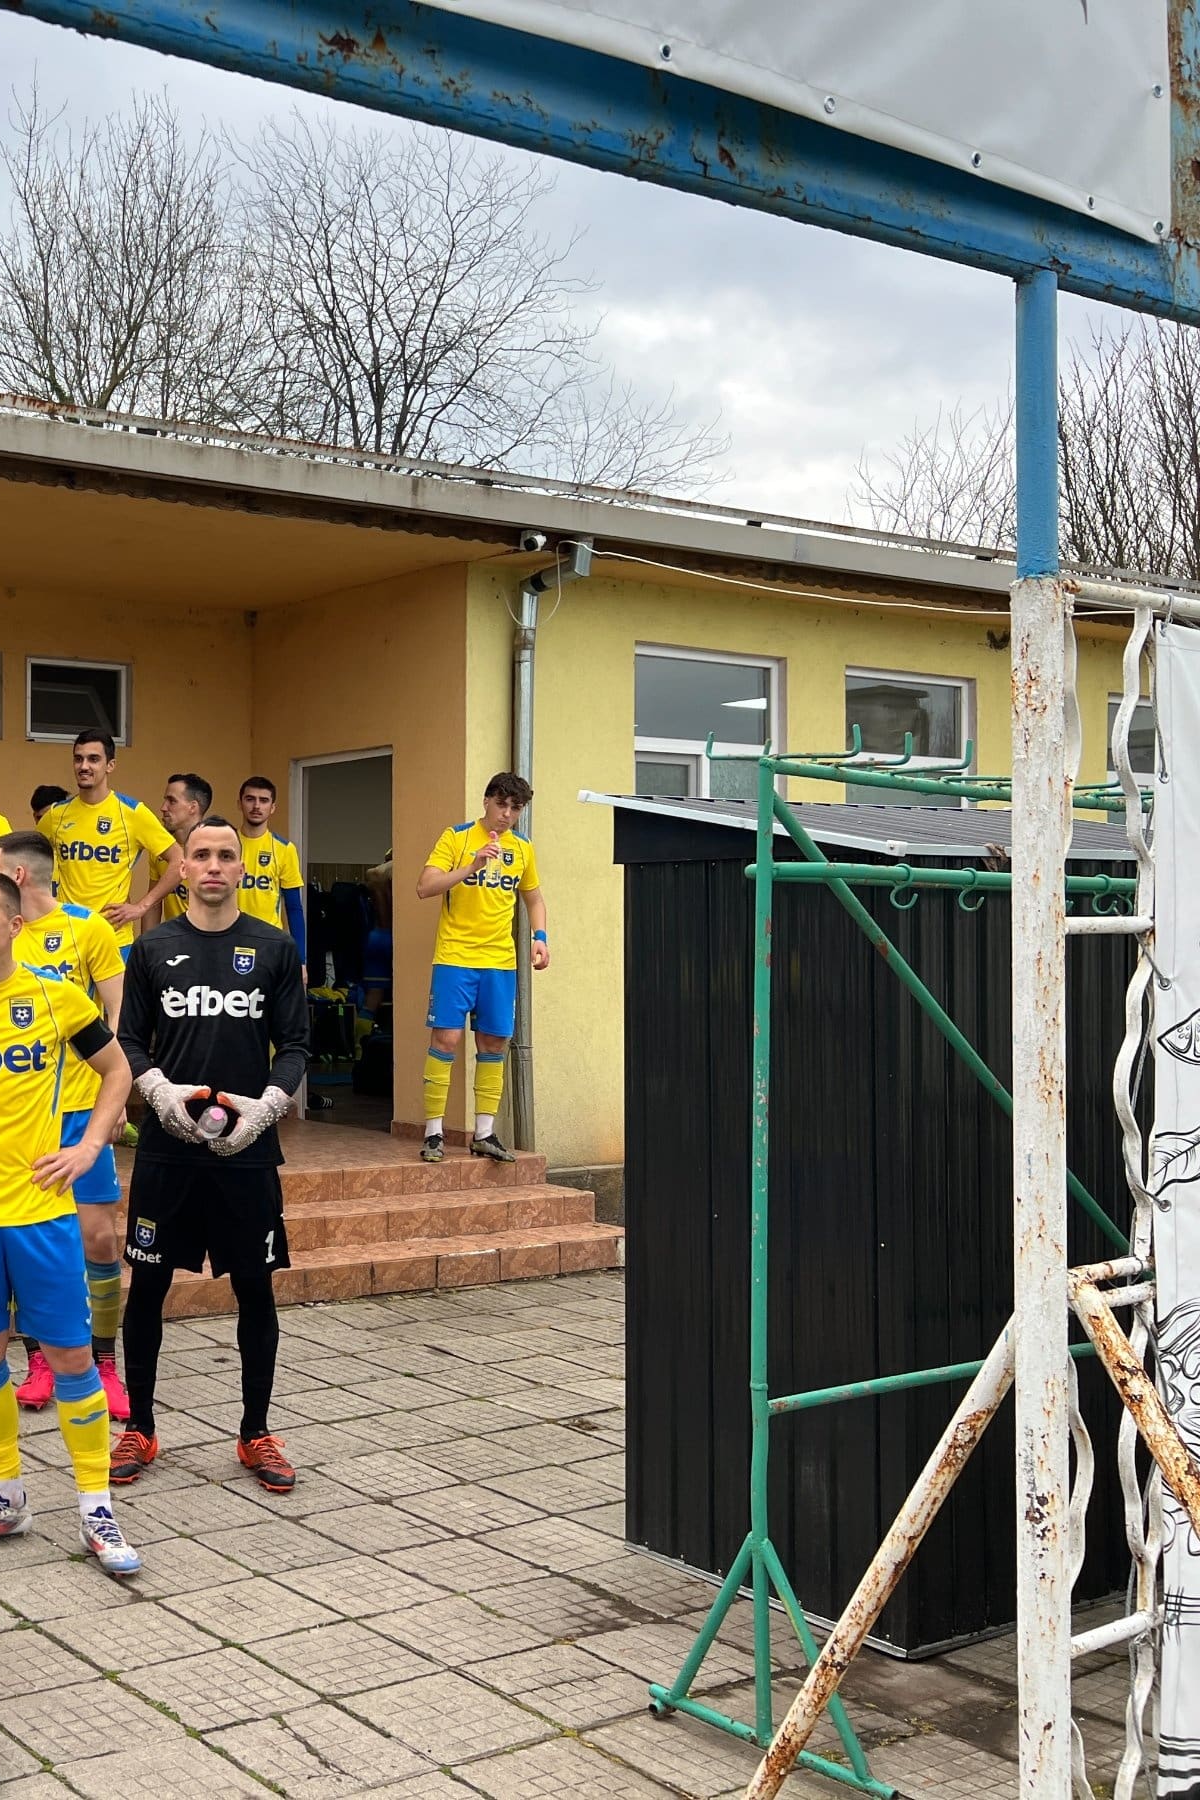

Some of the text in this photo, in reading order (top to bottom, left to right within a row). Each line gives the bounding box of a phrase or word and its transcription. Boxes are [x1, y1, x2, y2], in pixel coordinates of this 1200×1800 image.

[59, 840, 122, 864] efbet
[161, 985, 266, 1019] efbet
[264, 1230, 276, 1264] 1
